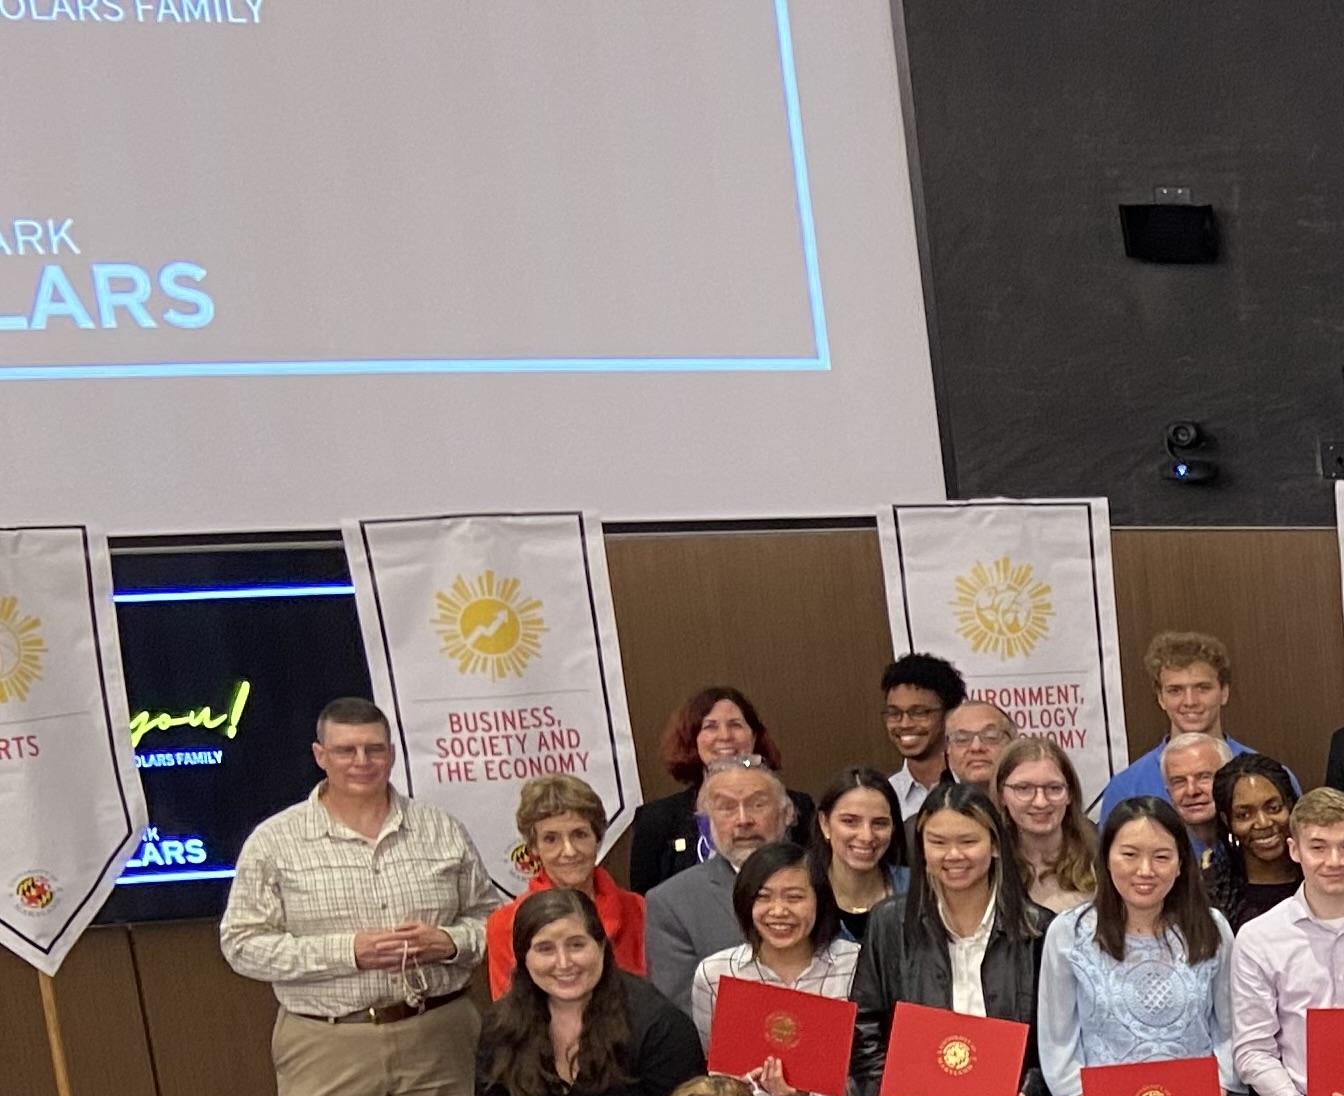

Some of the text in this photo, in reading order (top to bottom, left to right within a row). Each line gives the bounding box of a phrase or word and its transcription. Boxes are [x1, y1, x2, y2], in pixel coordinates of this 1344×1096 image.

[0, 0, 262, 24] OLARS FAMILY
[0, 217, 81, 255] RK
[448, 705, 562, 734] BUSINESS,
[0, 735, 39, 760] RTS
[435, 728, 582, 759] SOCIETY AND
[135, 750, 223, 768] OLARS FAMILY
[432, 751, 590, 784] THE ECONOMY
